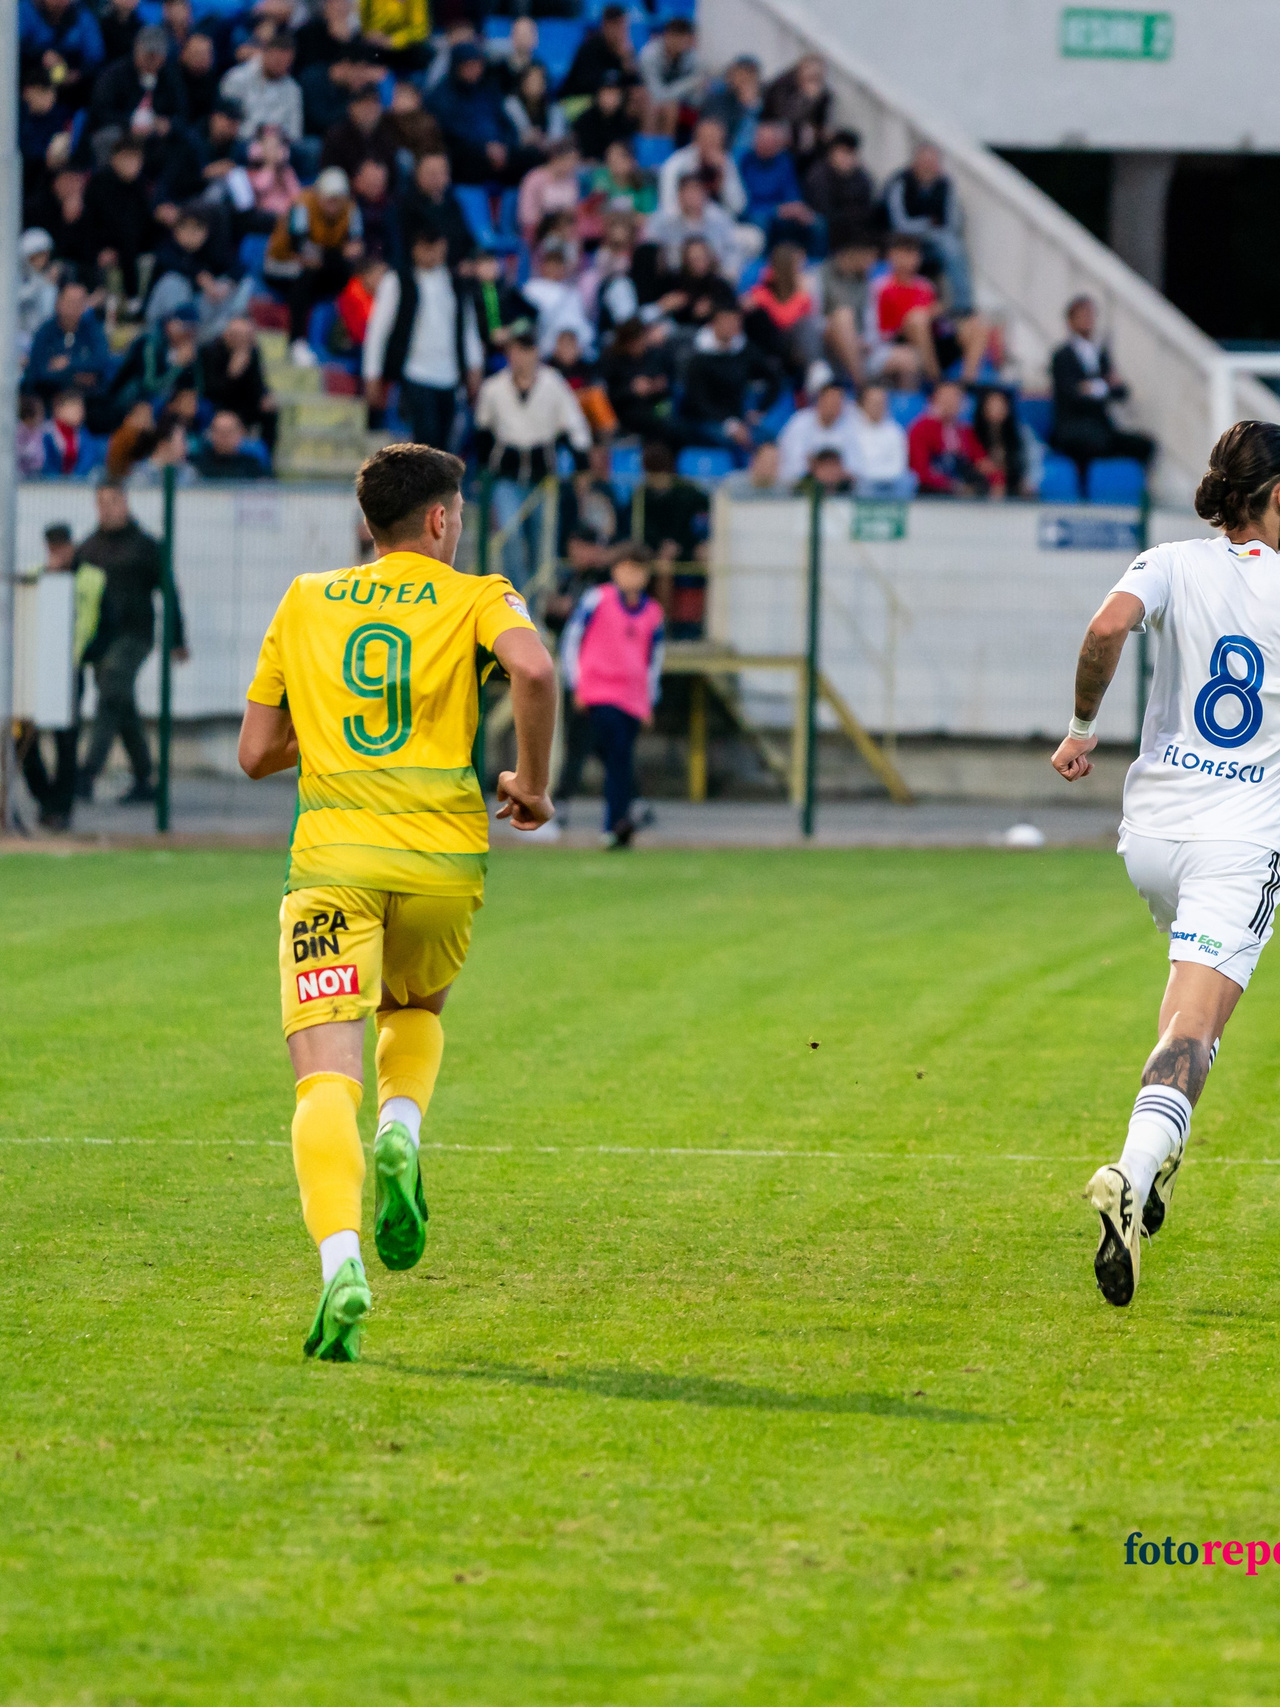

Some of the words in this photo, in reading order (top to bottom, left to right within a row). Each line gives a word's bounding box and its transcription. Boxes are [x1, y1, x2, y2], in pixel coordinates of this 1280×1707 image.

[342, 622, 412, 757] 9
[1194, 634, 1265, 748] 8
[1163, 744, 1265, 783] FLORESCU
[293, 911, 349, 939] APA
[1171, 931, 1197, 942] mart
[1198, 934, 1222, 949] Eco
[293, 934, 340, 964] DIN
[1198, 944, 1219, 957] Plus
[298, 967, 355, 1001] NOY
